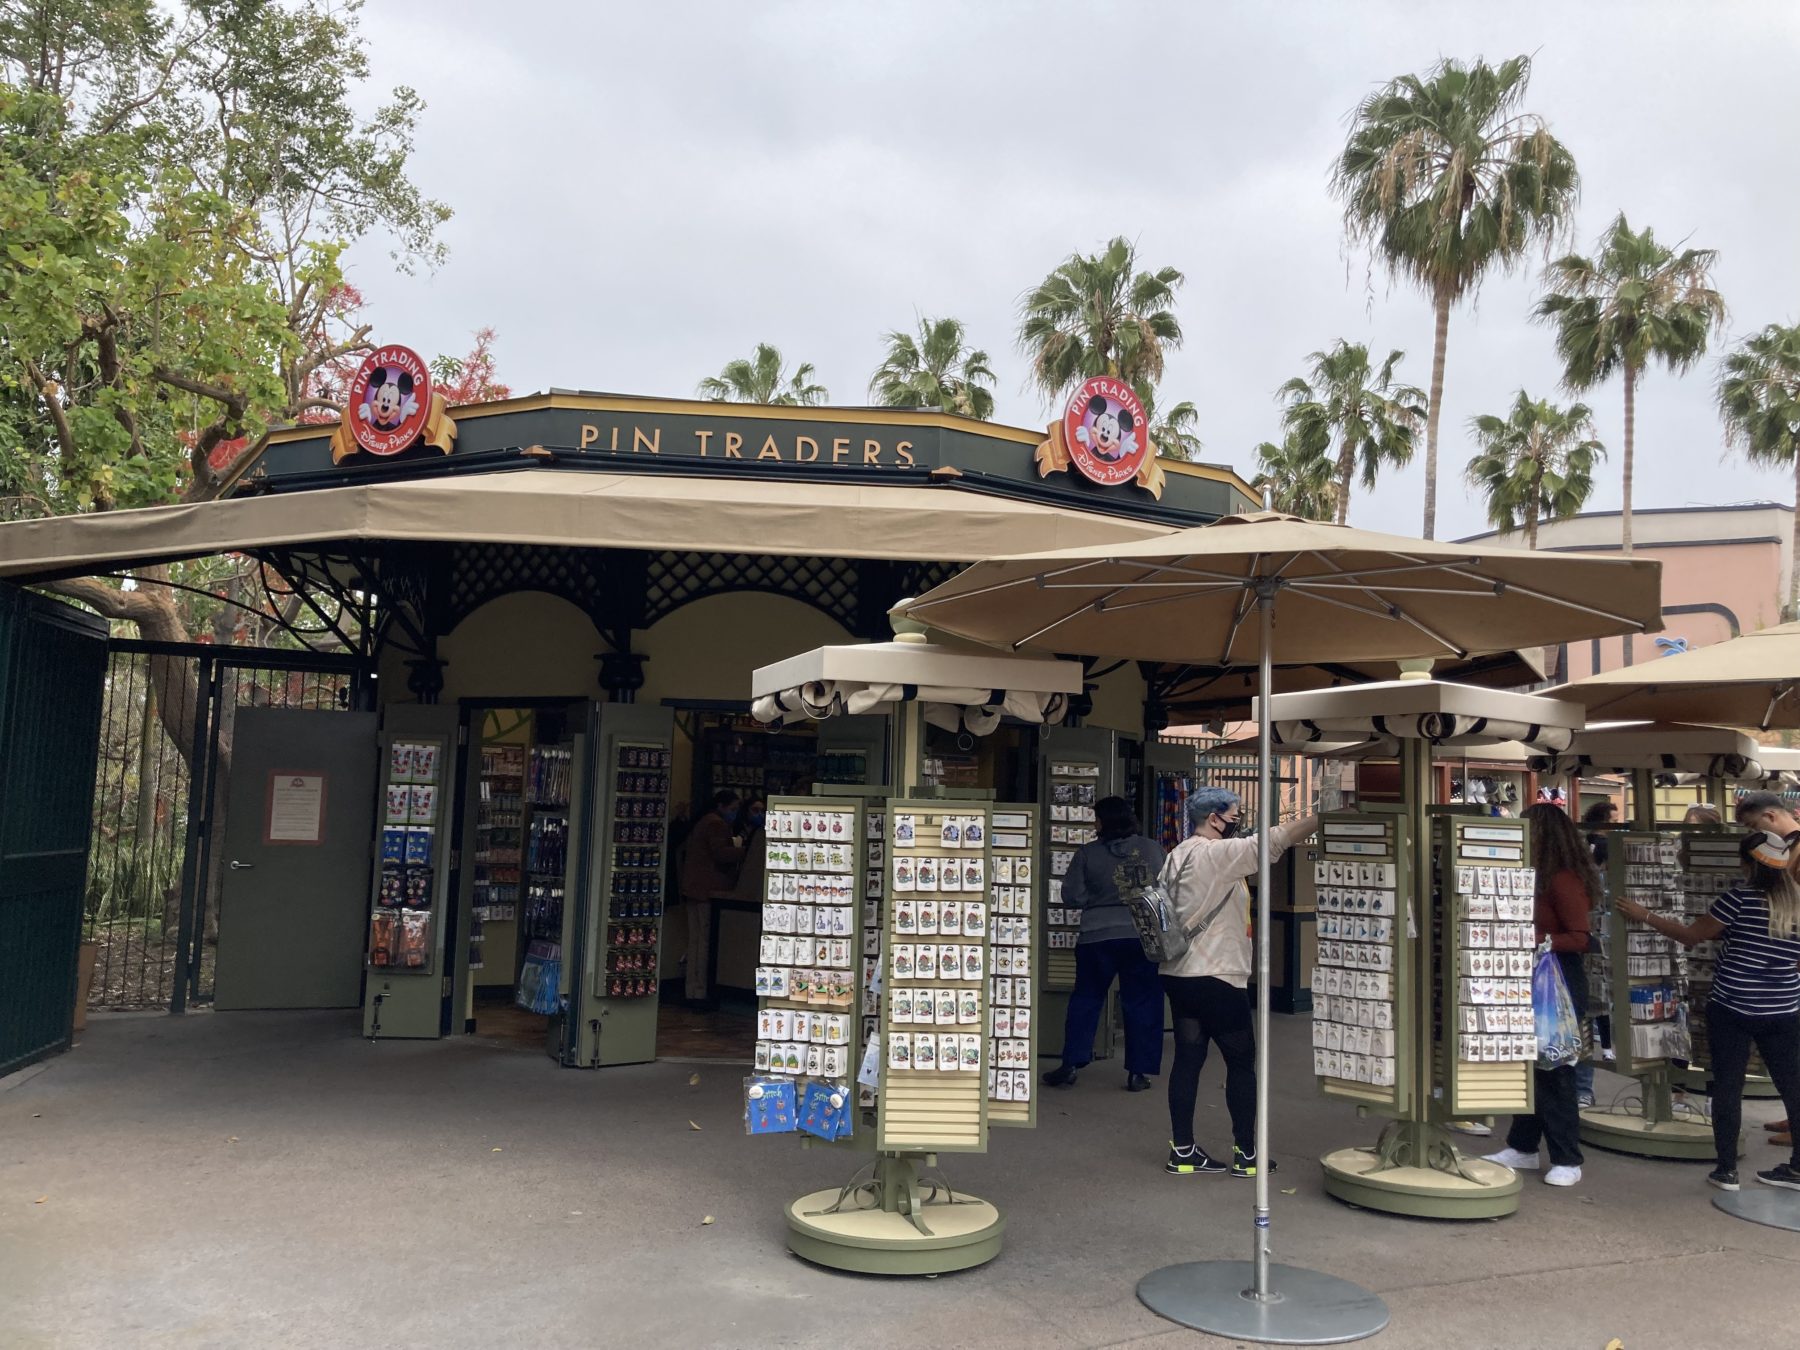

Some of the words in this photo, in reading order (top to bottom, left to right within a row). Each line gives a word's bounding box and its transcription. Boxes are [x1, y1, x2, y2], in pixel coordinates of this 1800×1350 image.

[353, 366, 372, 394] PIN
[371, 350, 424, 386] TRADING
[1071, 390, 1090, 415] PIN
[1091, 381, 1143, 427] TRADING
[580, 424, 661, 456] PIN
[695, 430, 914, 469] TRADERS
